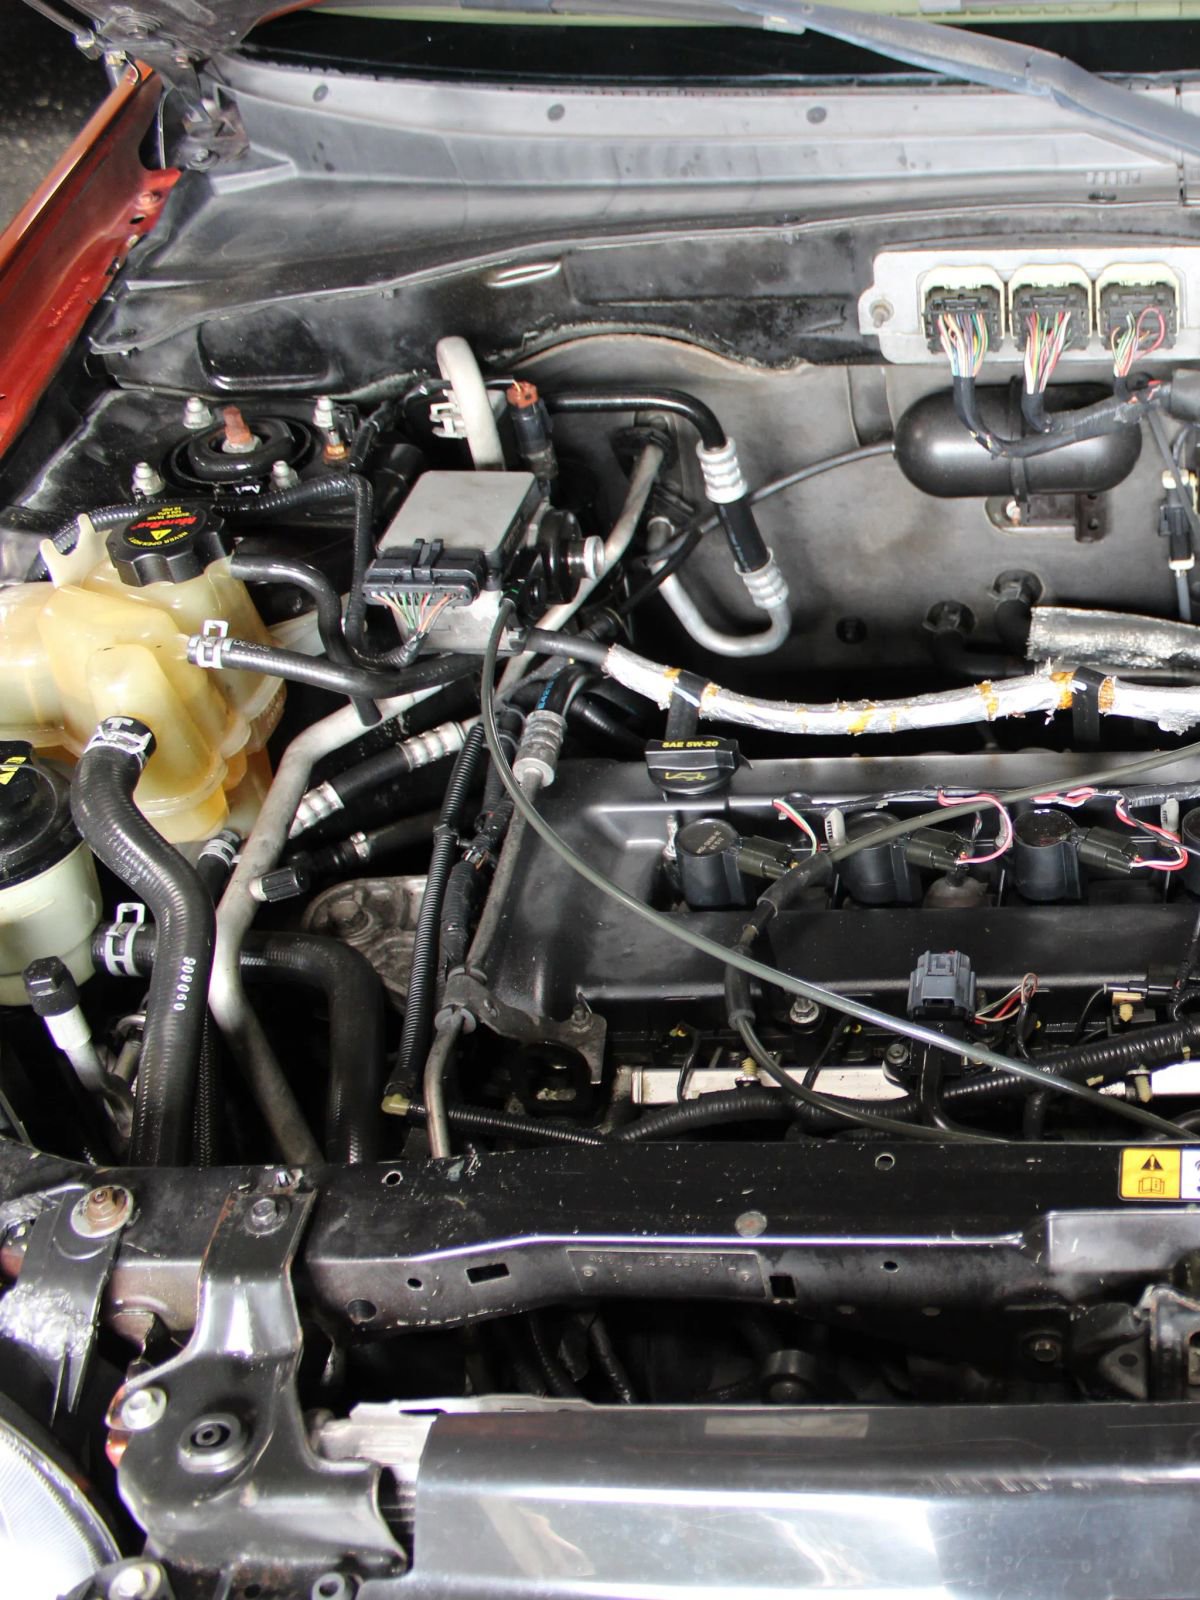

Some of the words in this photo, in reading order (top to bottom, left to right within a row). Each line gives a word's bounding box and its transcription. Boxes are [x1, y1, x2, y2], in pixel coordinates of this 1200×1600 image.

[233, 639, 271, 653] DEGAS
[686, 740, 719, 748] 5W-20
[173, 956, 197, 1011] 090606
